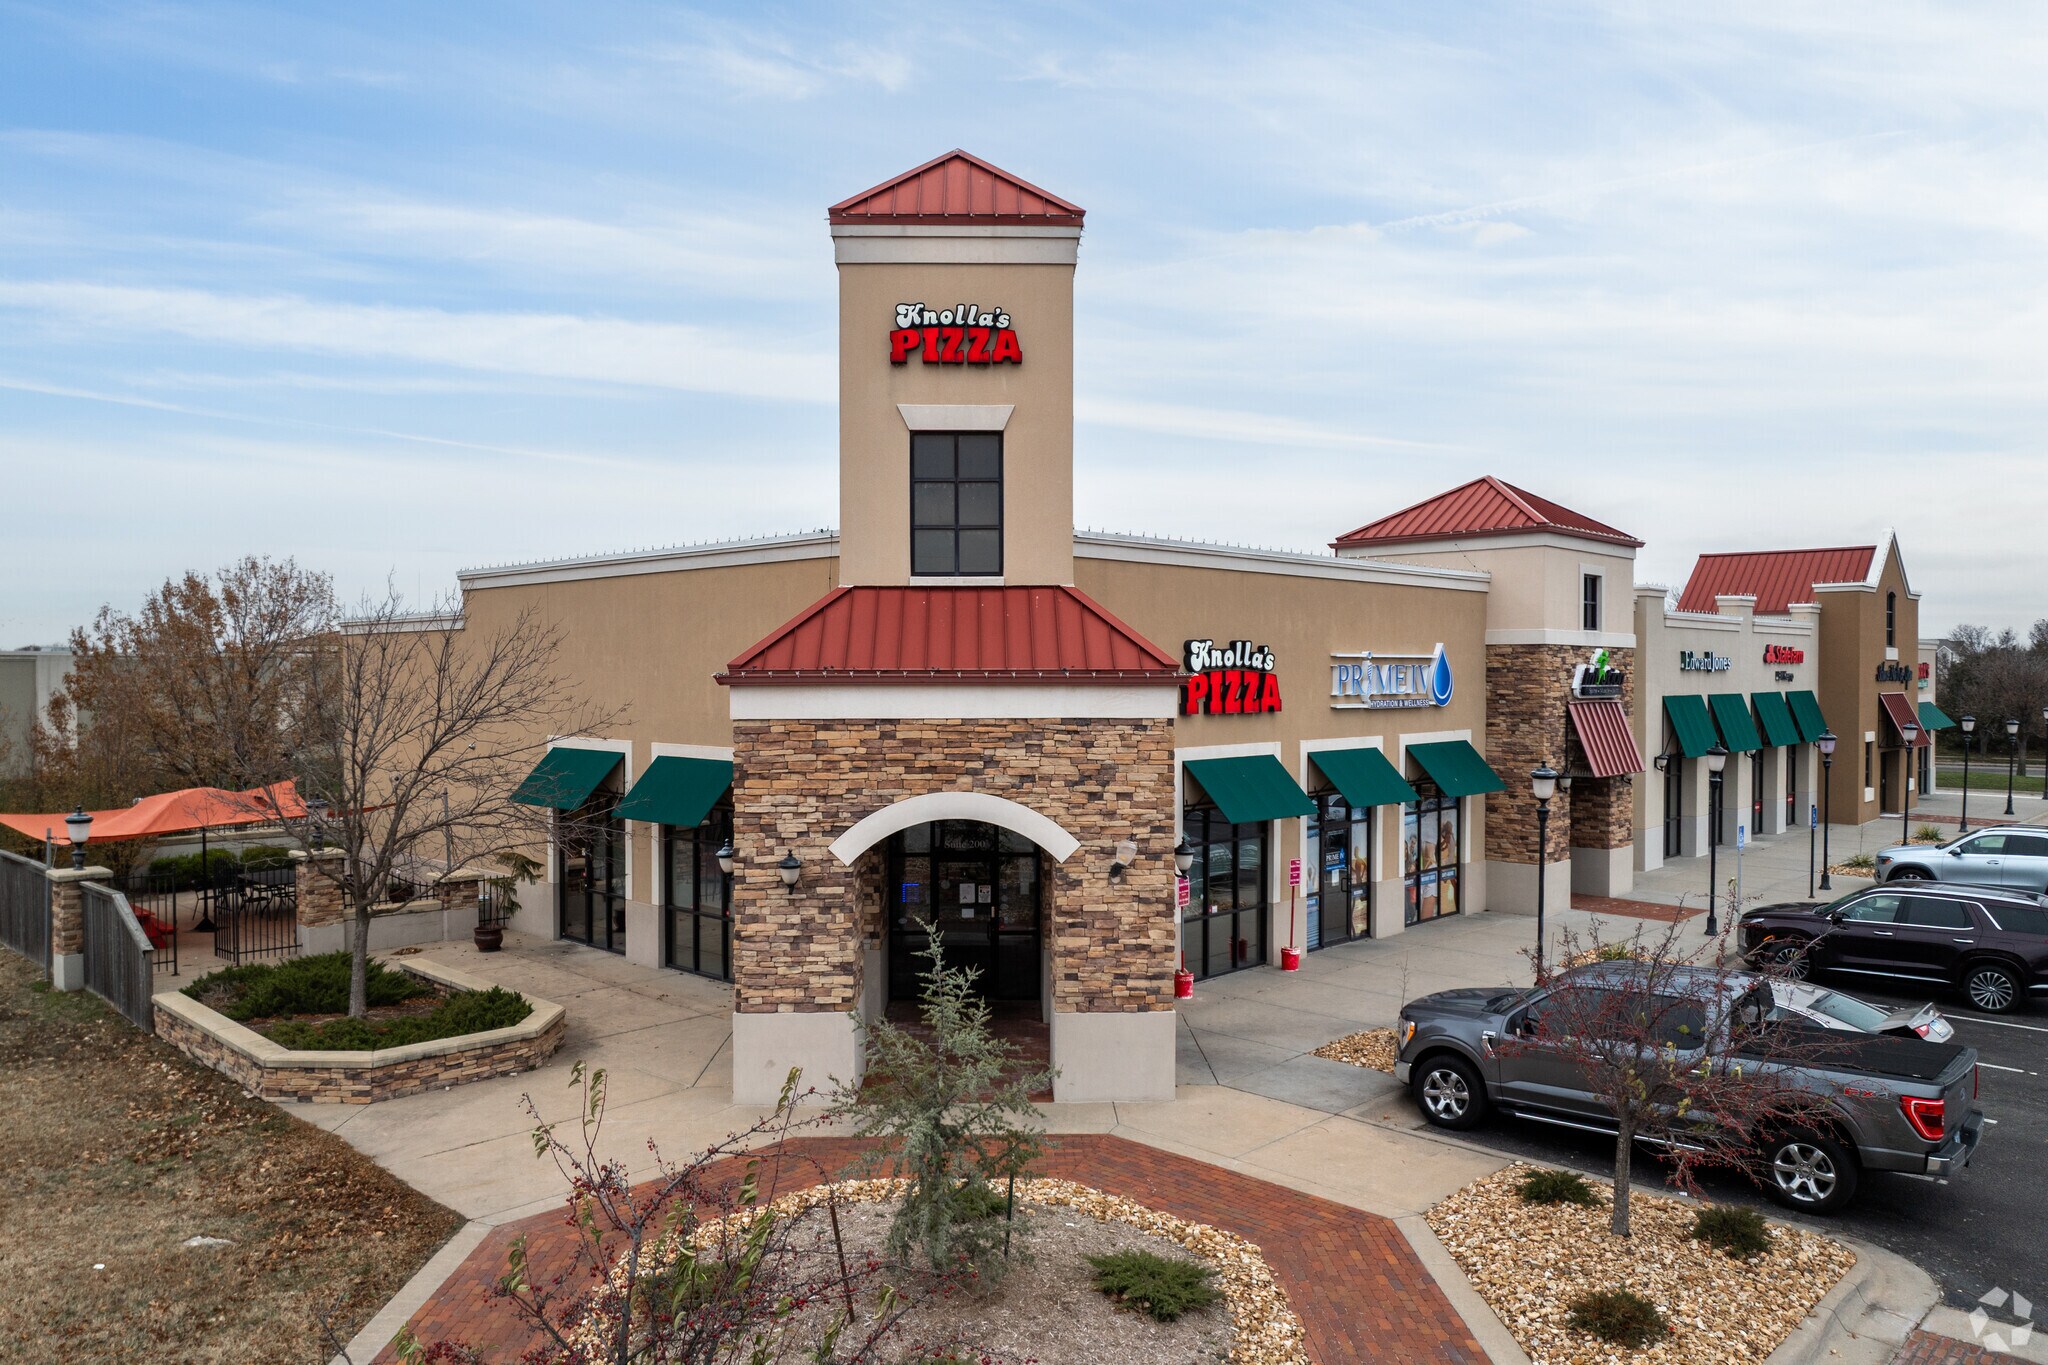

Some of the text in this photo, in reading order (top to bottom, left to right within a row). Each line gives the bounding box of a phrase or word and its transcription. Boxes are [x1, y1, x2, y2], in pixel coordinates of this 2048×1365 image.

[895, 303, 1011, 329] Knolla's
[890, 327, 1022, 364] PIZZA
[1187, 640, 1275, 672] Knolla's
[1184, 670, 1282, 715] PIZZA
[1369, 700, 1397, 709] HYDRATION
[1404, 699, 1430, 708] WELLNESS
[969, 840, 986, 849] 200
